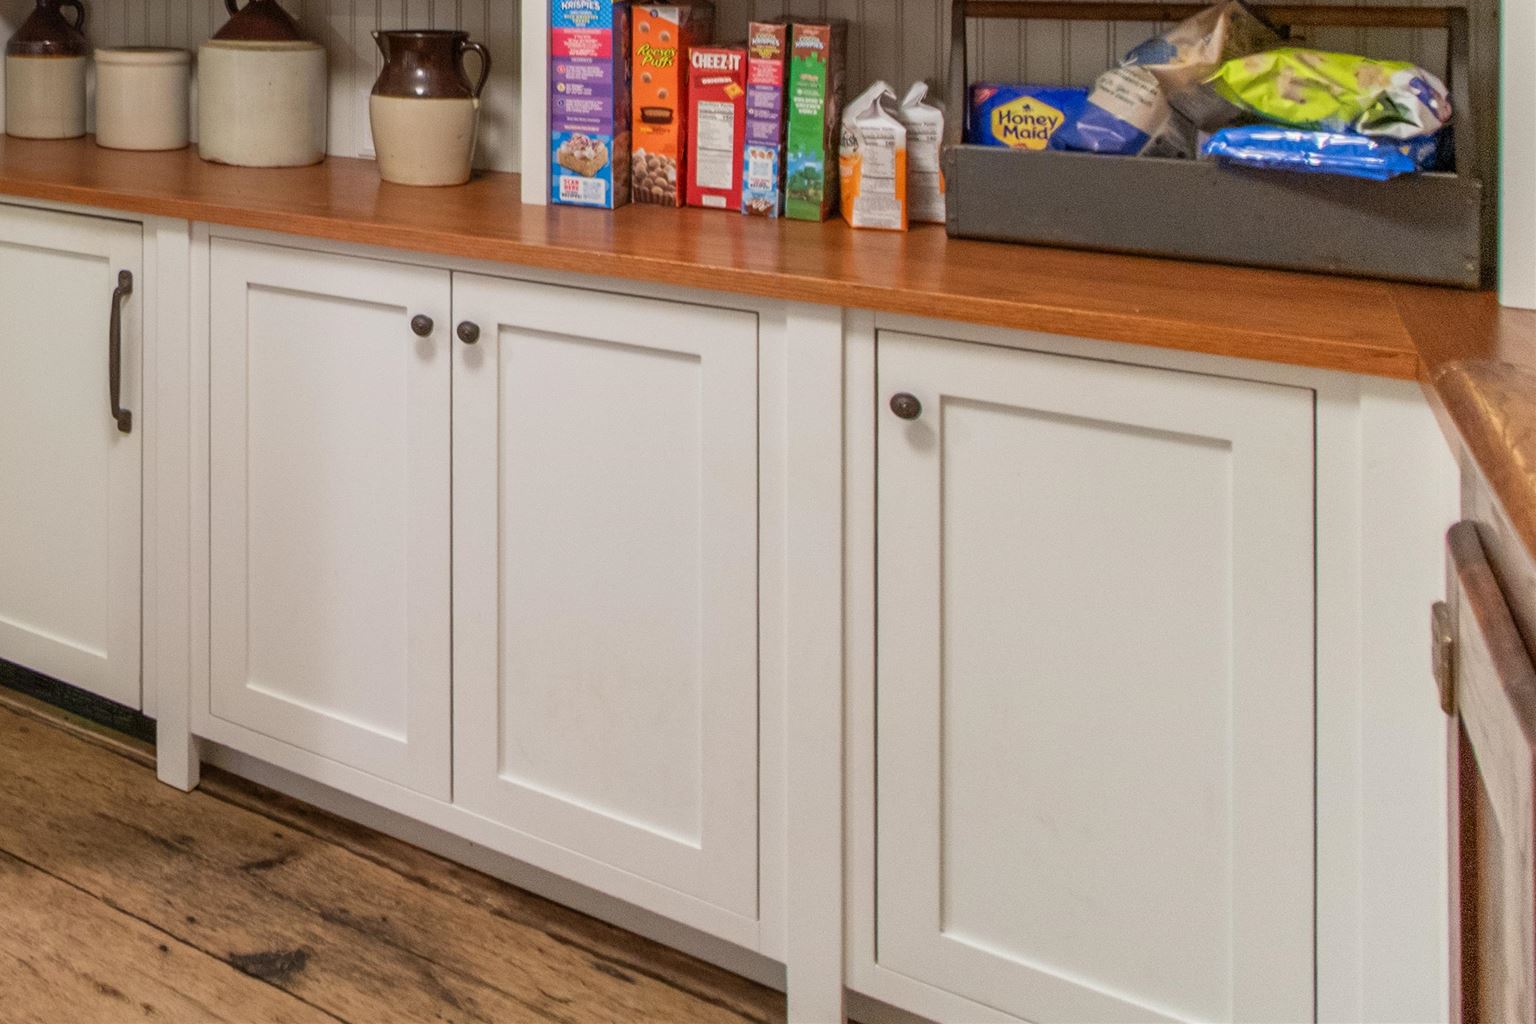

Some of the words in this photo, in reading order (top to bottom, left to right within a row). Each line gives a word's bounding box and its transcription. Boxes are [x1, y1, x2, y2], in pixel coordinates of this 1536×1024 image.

[560, 0, 601, 11] KRISPIES
[640, 55, 674, 69] Puffs
[997, 109, 1060, 130] Honey
[1002, 125, 1050, 141] Maid
